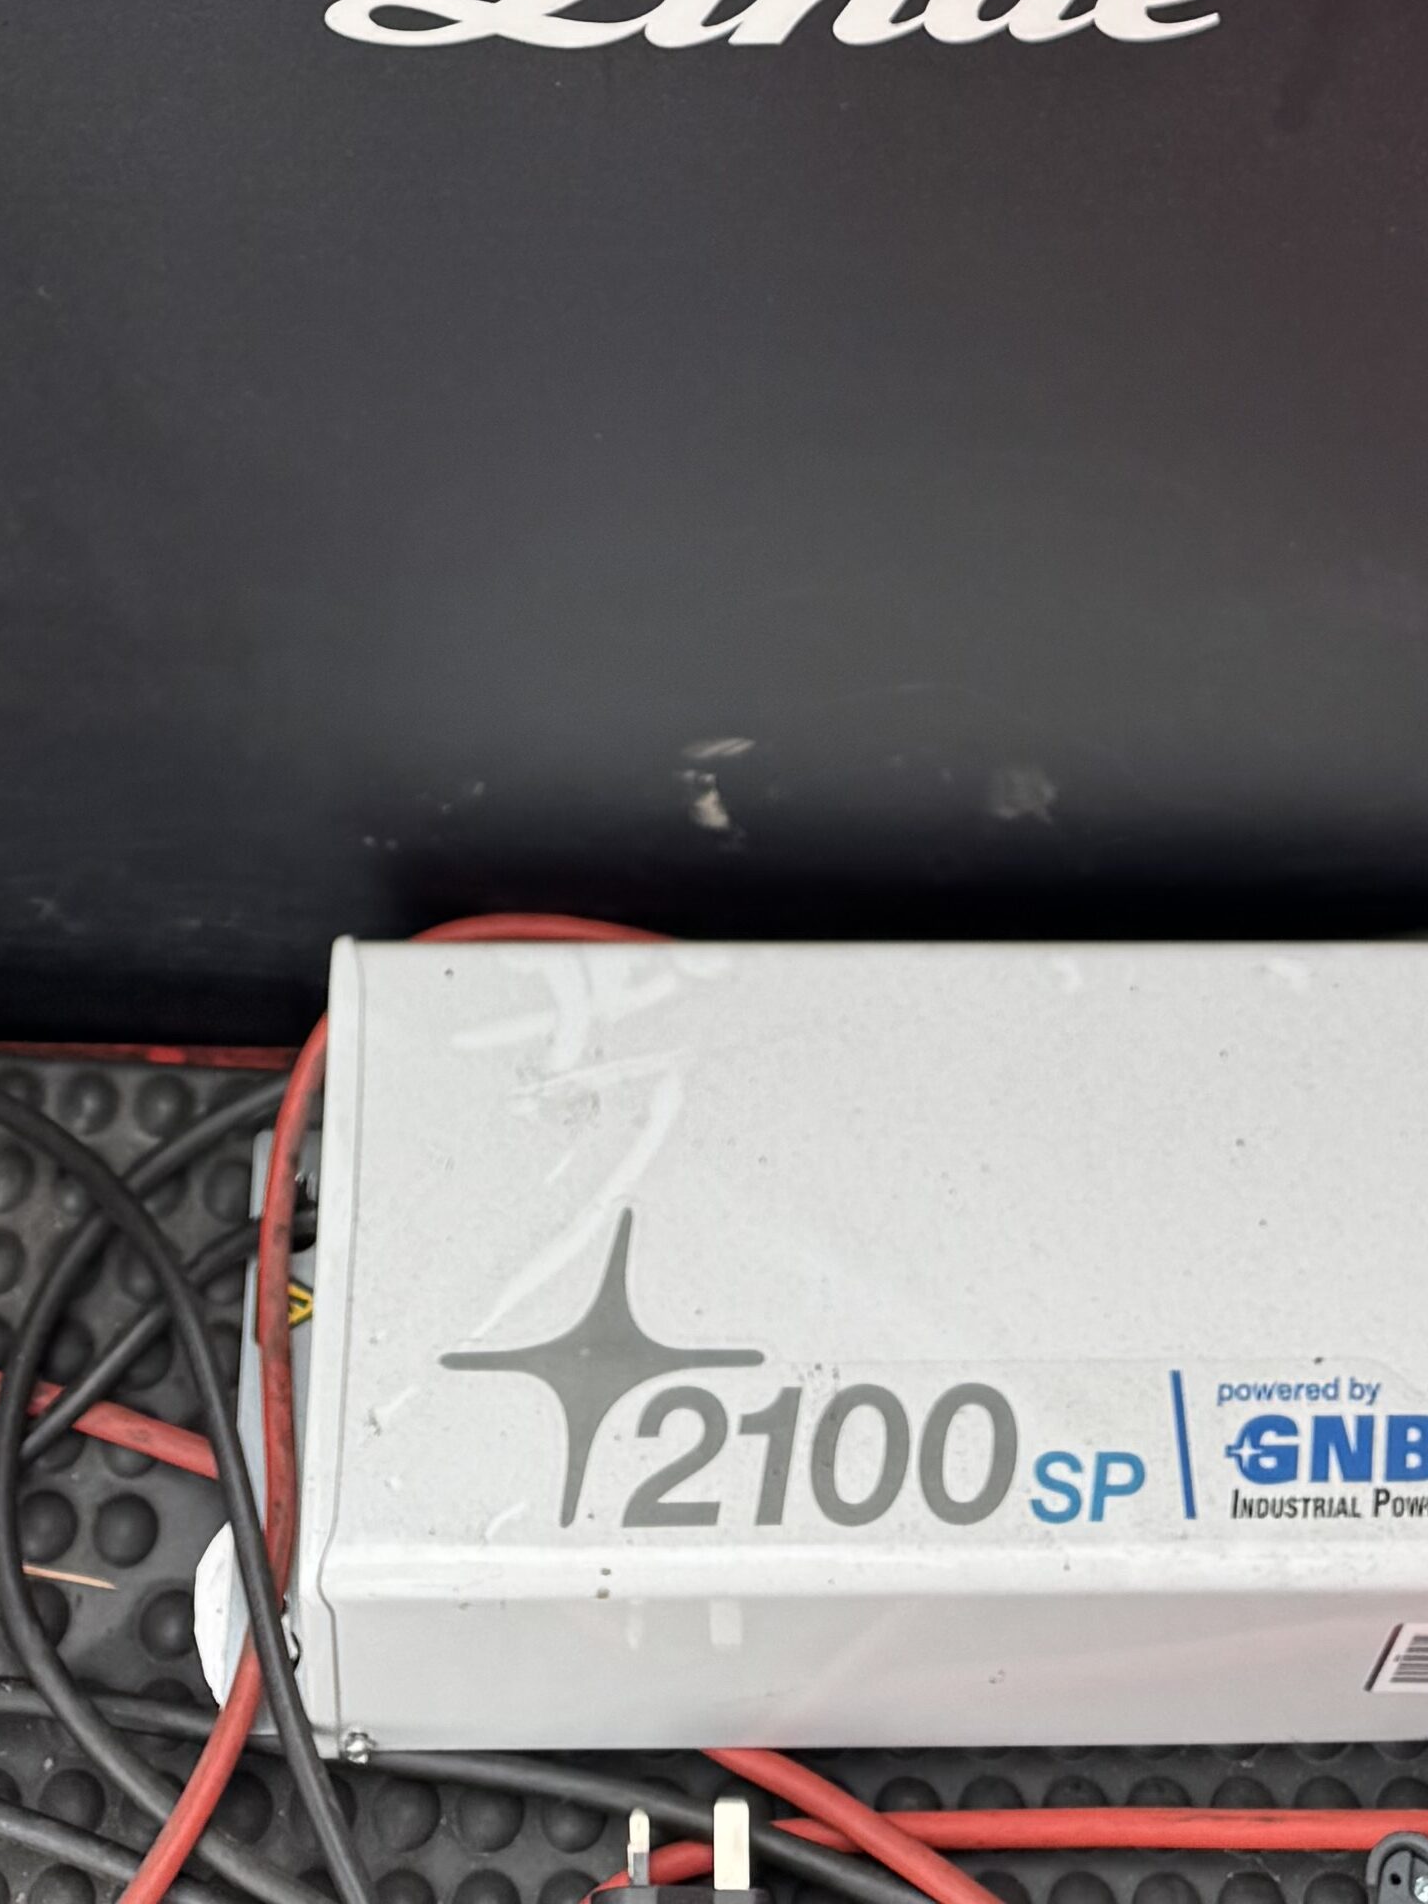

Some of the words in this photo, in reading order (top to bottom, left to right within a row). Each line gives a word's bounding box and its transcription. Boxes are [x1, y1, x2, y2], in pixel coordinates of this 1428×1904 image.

[1217, 1377, 1339, 1406] powered
[1348, 1377, 1381, 1405] by
[622, 1382, 1018, 1528] 2100
[1029, 1451, 1146, 1524] SP
